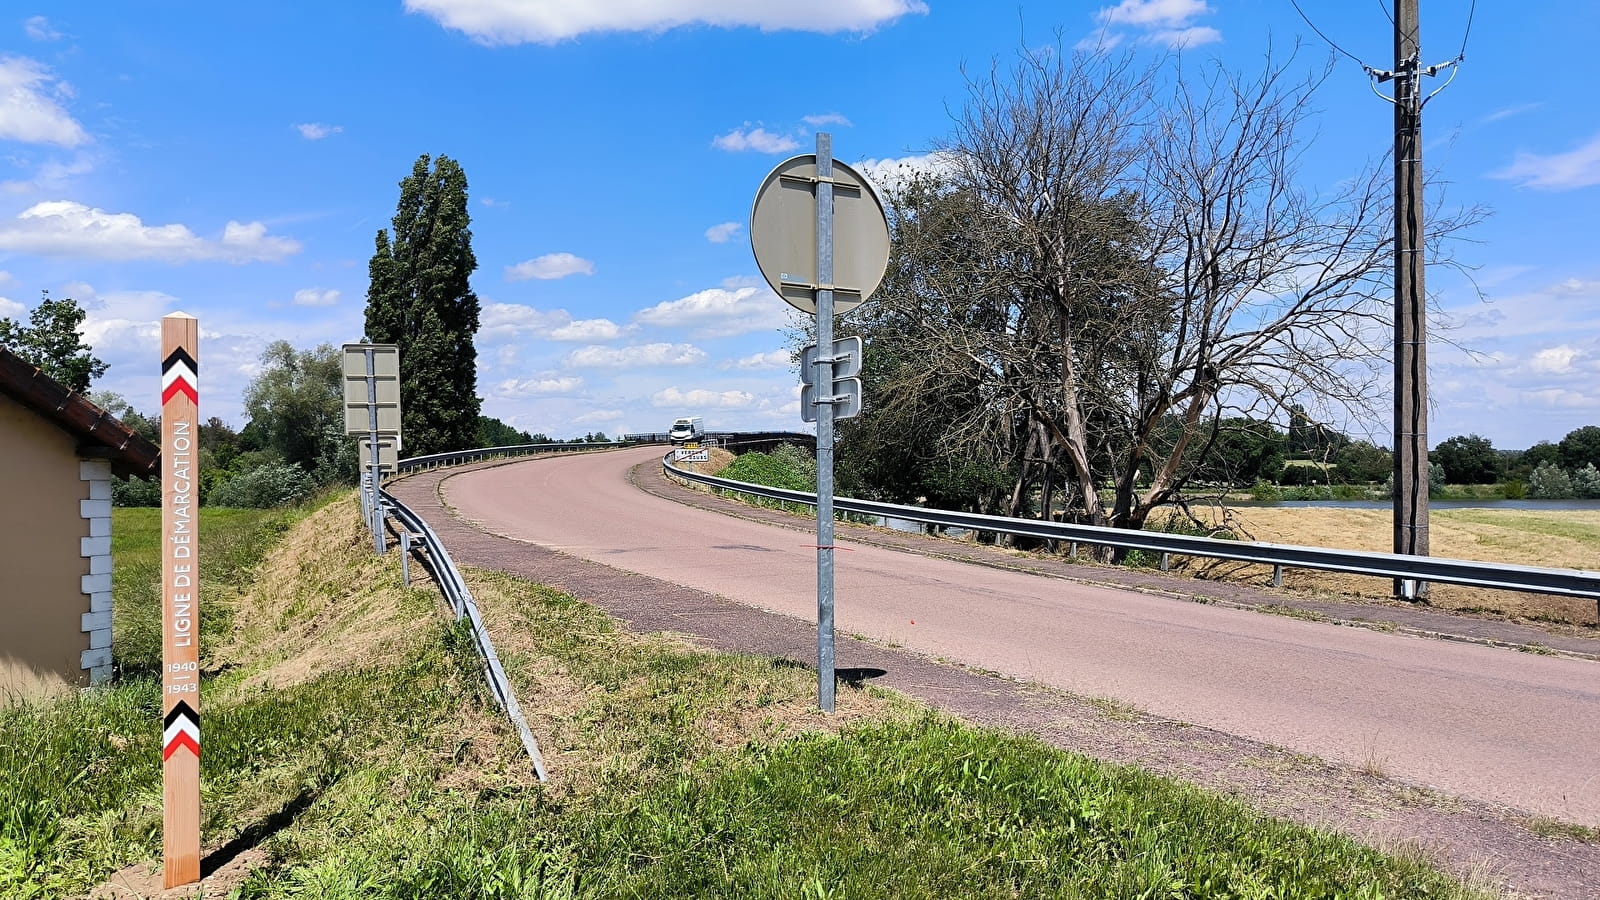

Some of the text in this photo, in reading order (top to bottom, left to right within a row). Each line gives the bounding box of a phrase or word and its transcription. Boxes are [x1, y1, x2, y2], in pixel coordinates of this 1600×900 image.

[170, 422, 191, 647] LIGNE DE DÉMARCATION
[167, 661, 197, 673] 1940
[166, 682, 197, 695] 1943
